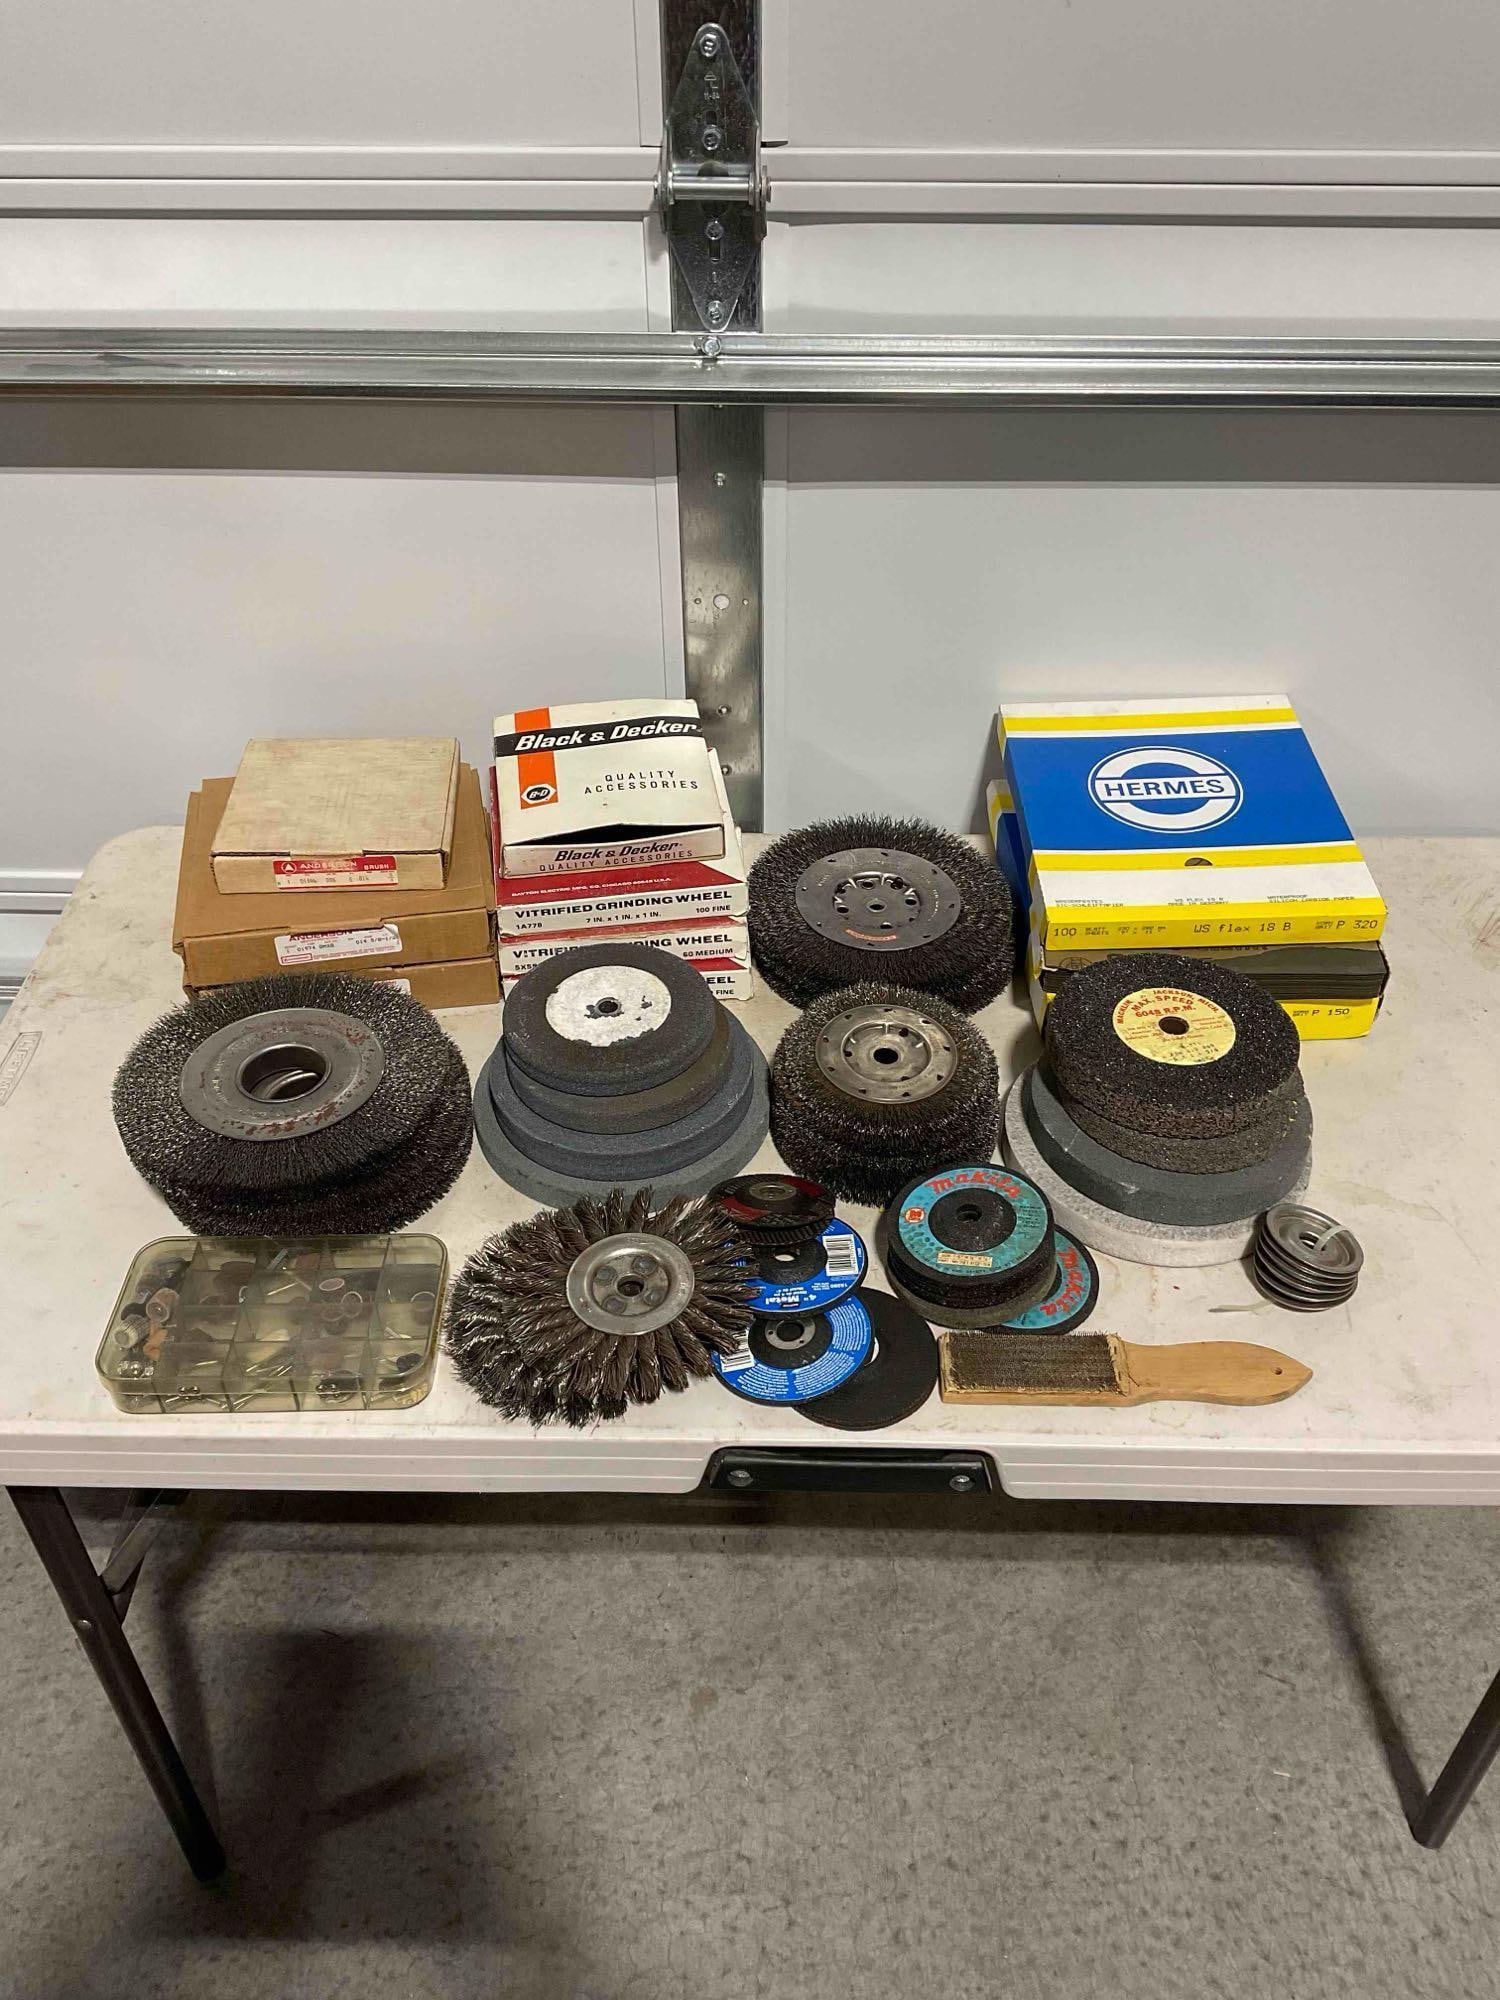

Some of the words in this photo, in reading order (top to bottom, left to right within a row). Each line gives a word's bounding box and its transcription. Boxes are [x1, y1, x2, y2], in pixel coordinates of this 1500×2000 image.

[515, 730, 585, 751] Black
[589, 731, 606, 742] &
[610, 719, 698, 741] Decker
[605, 770, 676, 782] QUALITY
[584, 780, 698, 794] ACCESSORIES
[1104, 778, 1225, 798] HERMES
[554, 849, 603, 862] Black
[605, 849, 616, 858] &
[619, 842, 680, 856] Decker
[363, 863, 390, 871] BRUSH
[539, 860, 594, 872] QUALITY
[604, 850, 693, 865] ACCESSORIES
[515, 904, 593, 918] VITRIFIED
[595, 896, 673, 911] GRINDING
[675, 891, 733, 903] WHEEL
[1194, 924, 1211, 934] WS
[1219, 923, 1251, 933] flex
[1260, 922, 1276, 932] 18
[1283, 922, 1292, 931] B
[1336, 920, 1346, 930] P
[1353, 920, 1378, 930] 320
[1054, 927, 1077, 937] 100
[676, 934, 733, 946] WHEEL
[695, 948, 733, 956] MEDIUM
[1155, 995, 1195, 1006] SPEED
[765, 1295, 800, 1305] Metal
